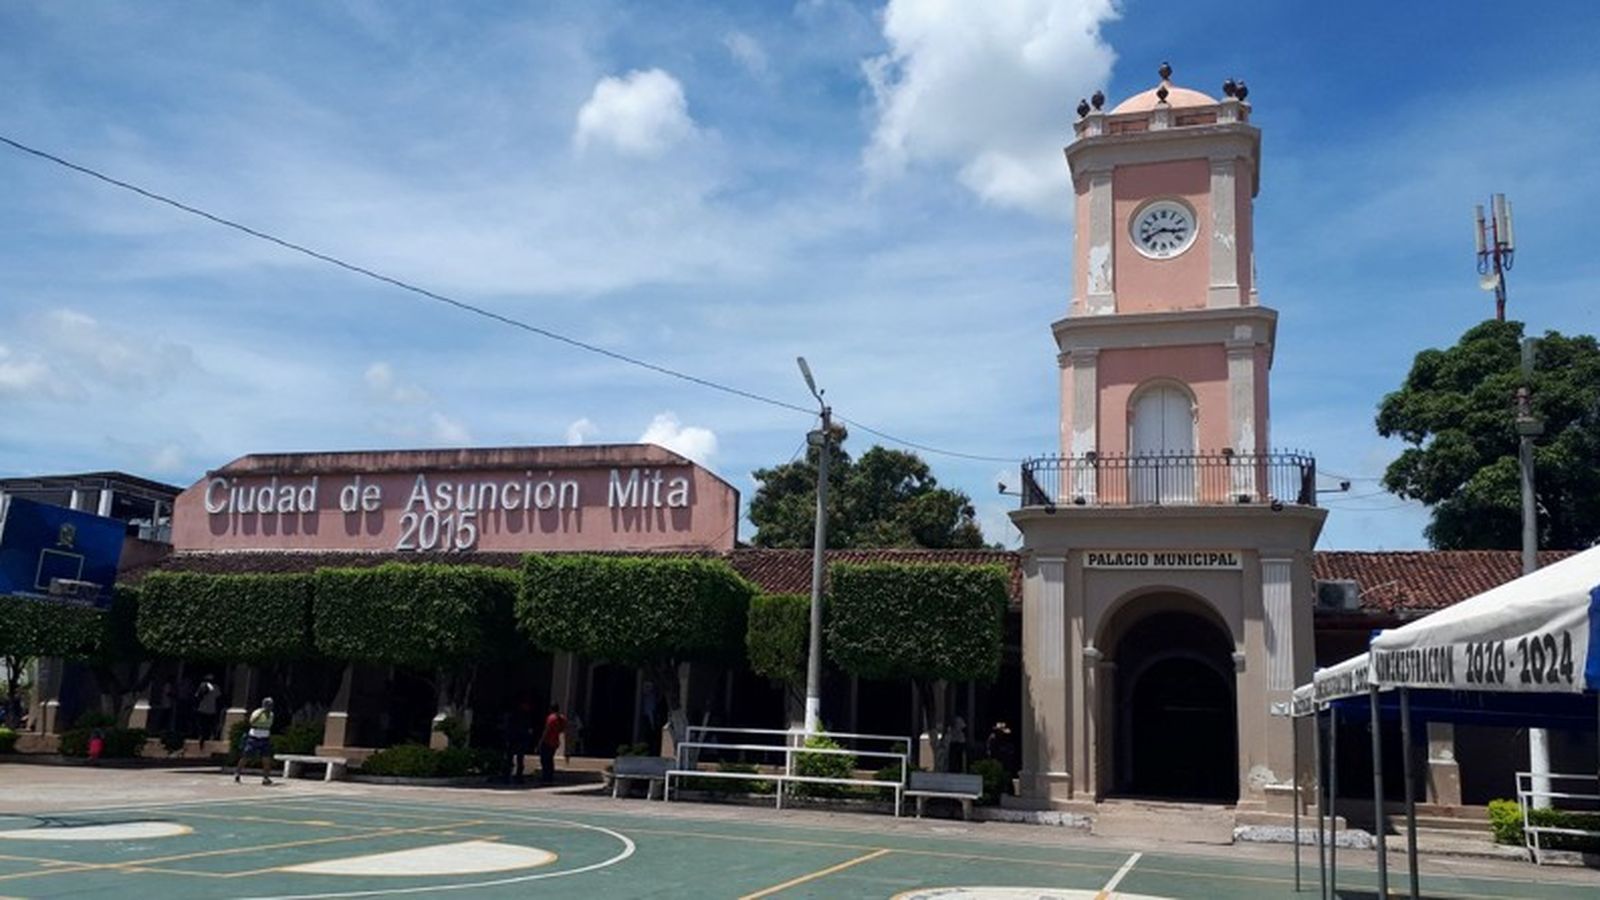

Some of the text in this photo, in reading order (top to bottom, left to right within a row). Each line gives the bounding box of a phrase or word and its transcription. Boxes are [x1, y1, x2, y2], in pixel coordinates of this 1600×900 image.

[204, 468, 690, 514] Ciudad de Asunción Mita
[396, 508, 477, 552] 2015
[1088, 553, 1237, 566] PALACIO MUNICIPAL
